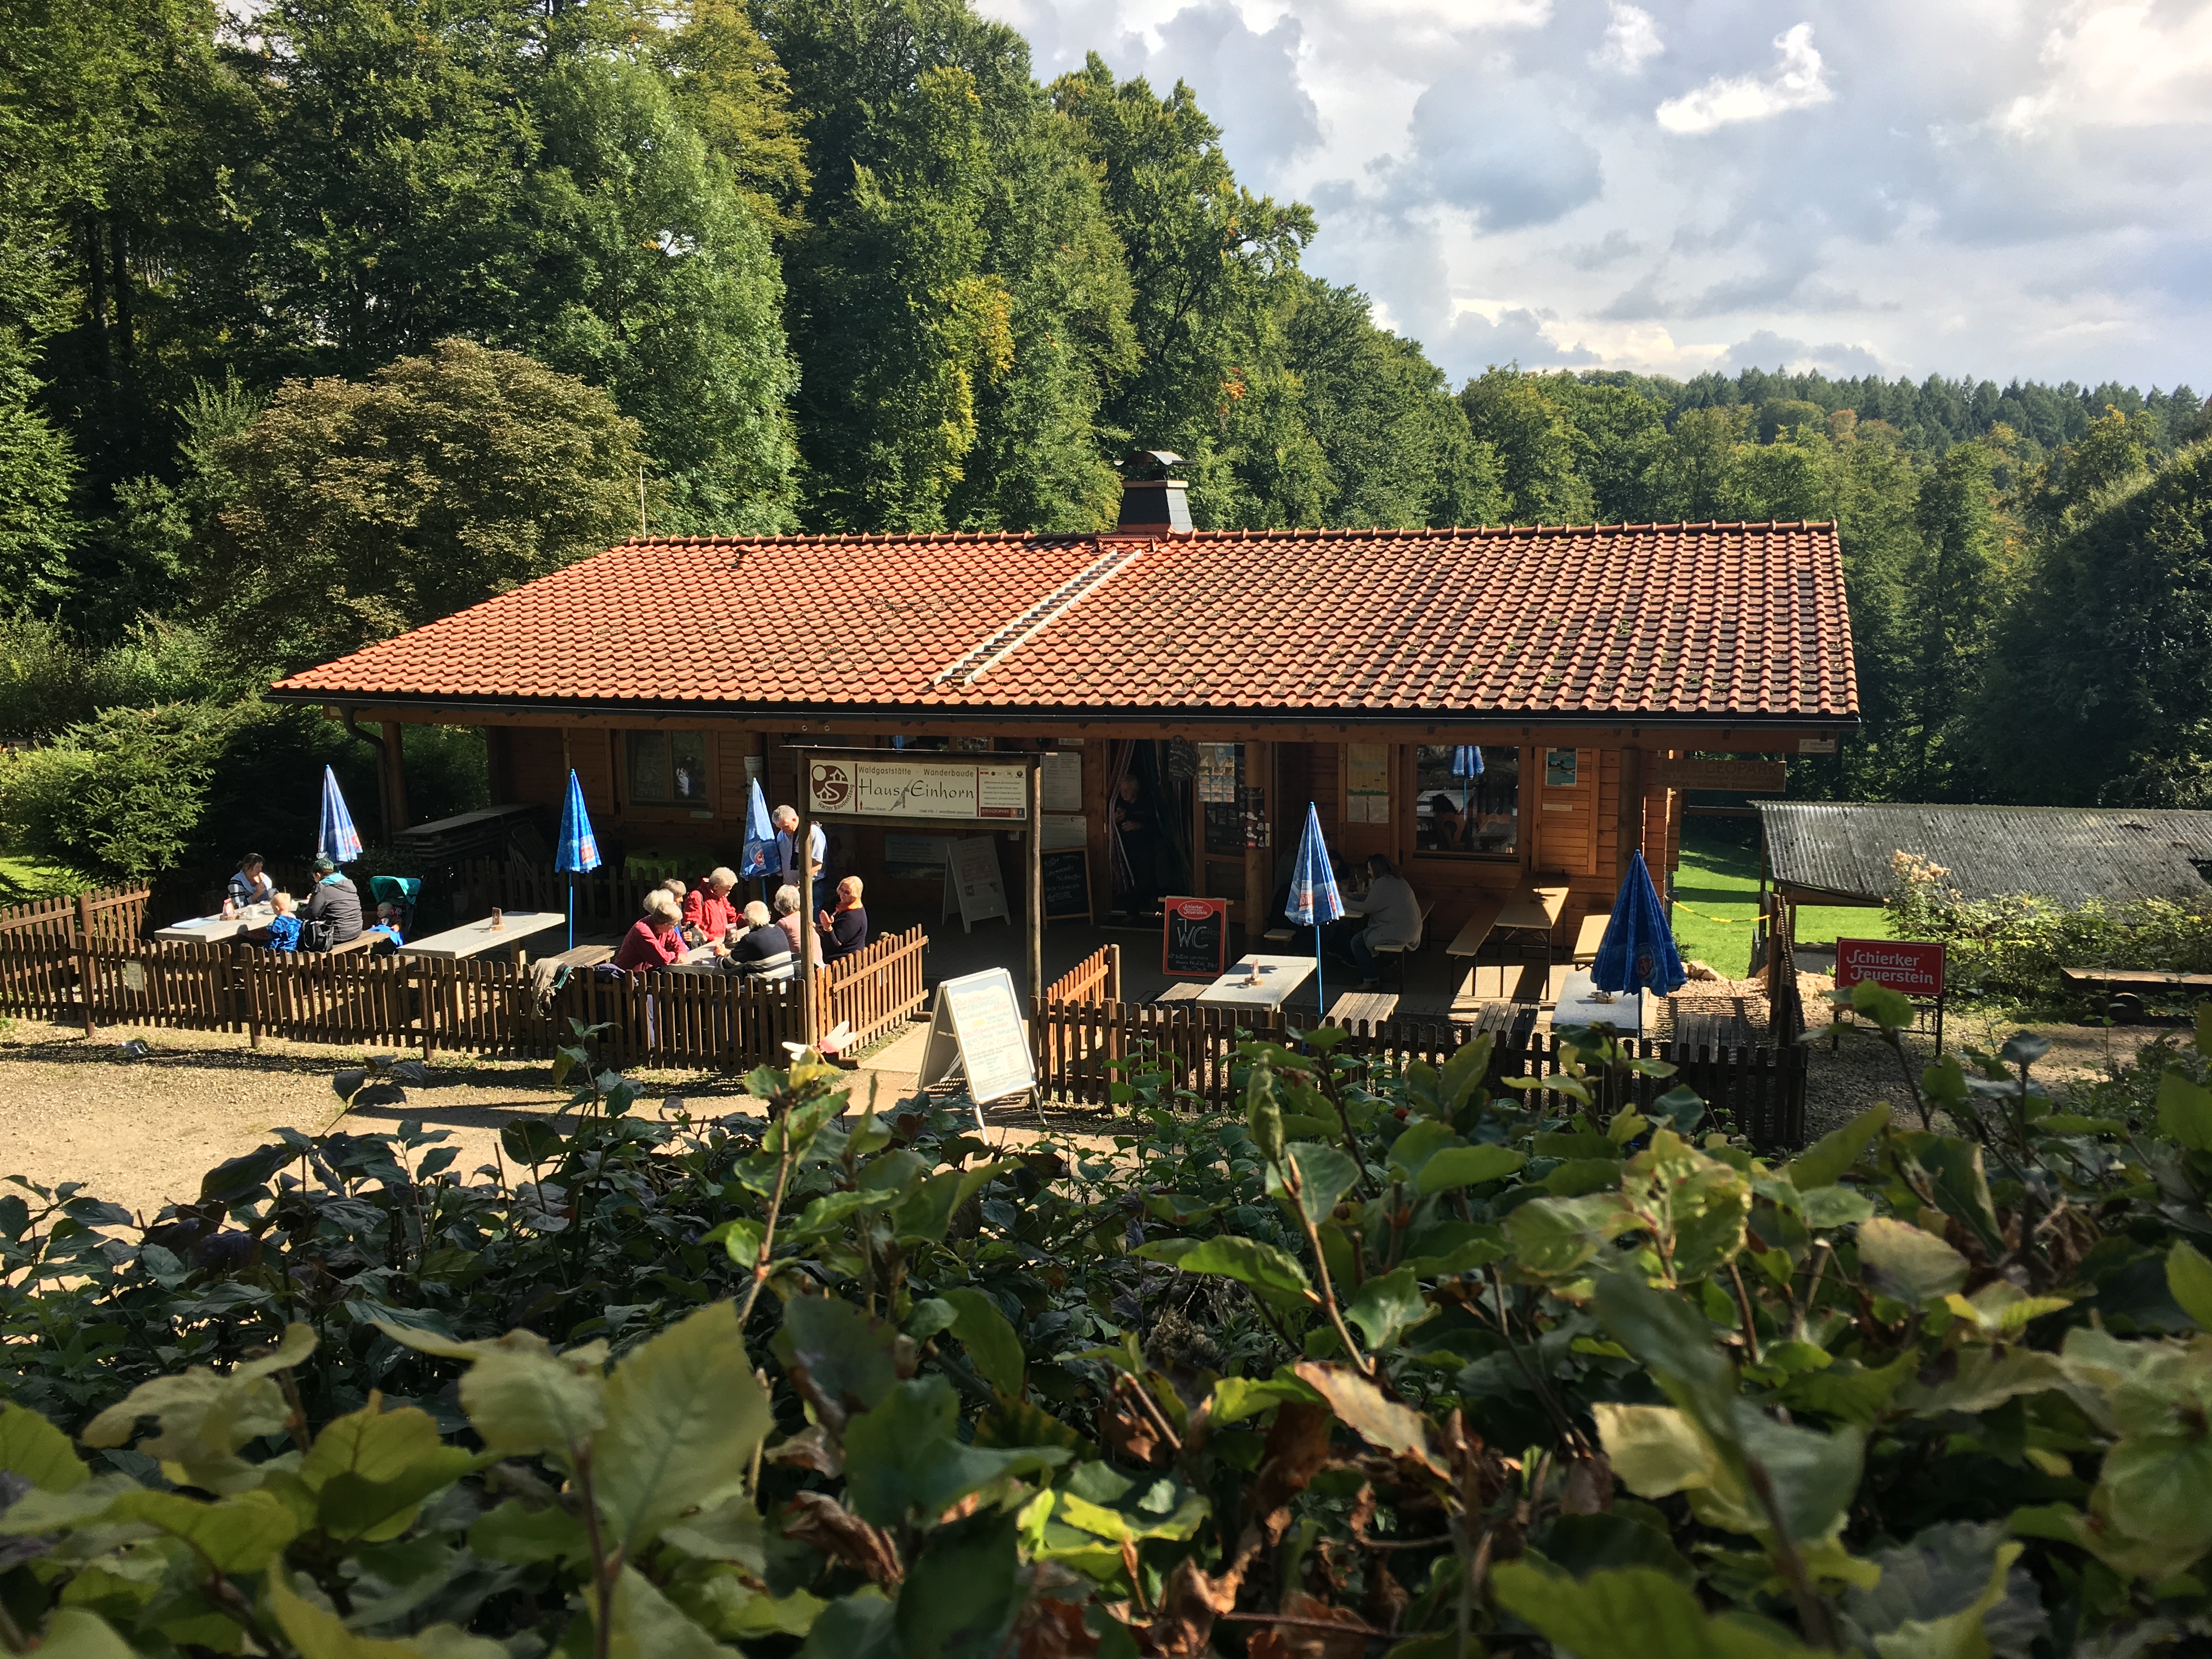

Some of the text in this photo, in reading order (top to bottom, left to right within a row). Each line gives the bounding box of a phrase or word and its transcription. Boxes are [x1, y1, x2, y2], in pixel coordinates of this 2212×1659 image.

[859, 766, 974, 777] Waldgaststätte Wanderbaude
[1705, 762, 1779, 775] GEOPARK
[859, 778, 974, 799] Haus Einhorn
[818, 802, 833, 811] Harzer
[1177, 926, 1209, 949] WC
[1846, 949, 1920, 966] Schierker
[1850, 965, 1933, 985] Feuerstein
